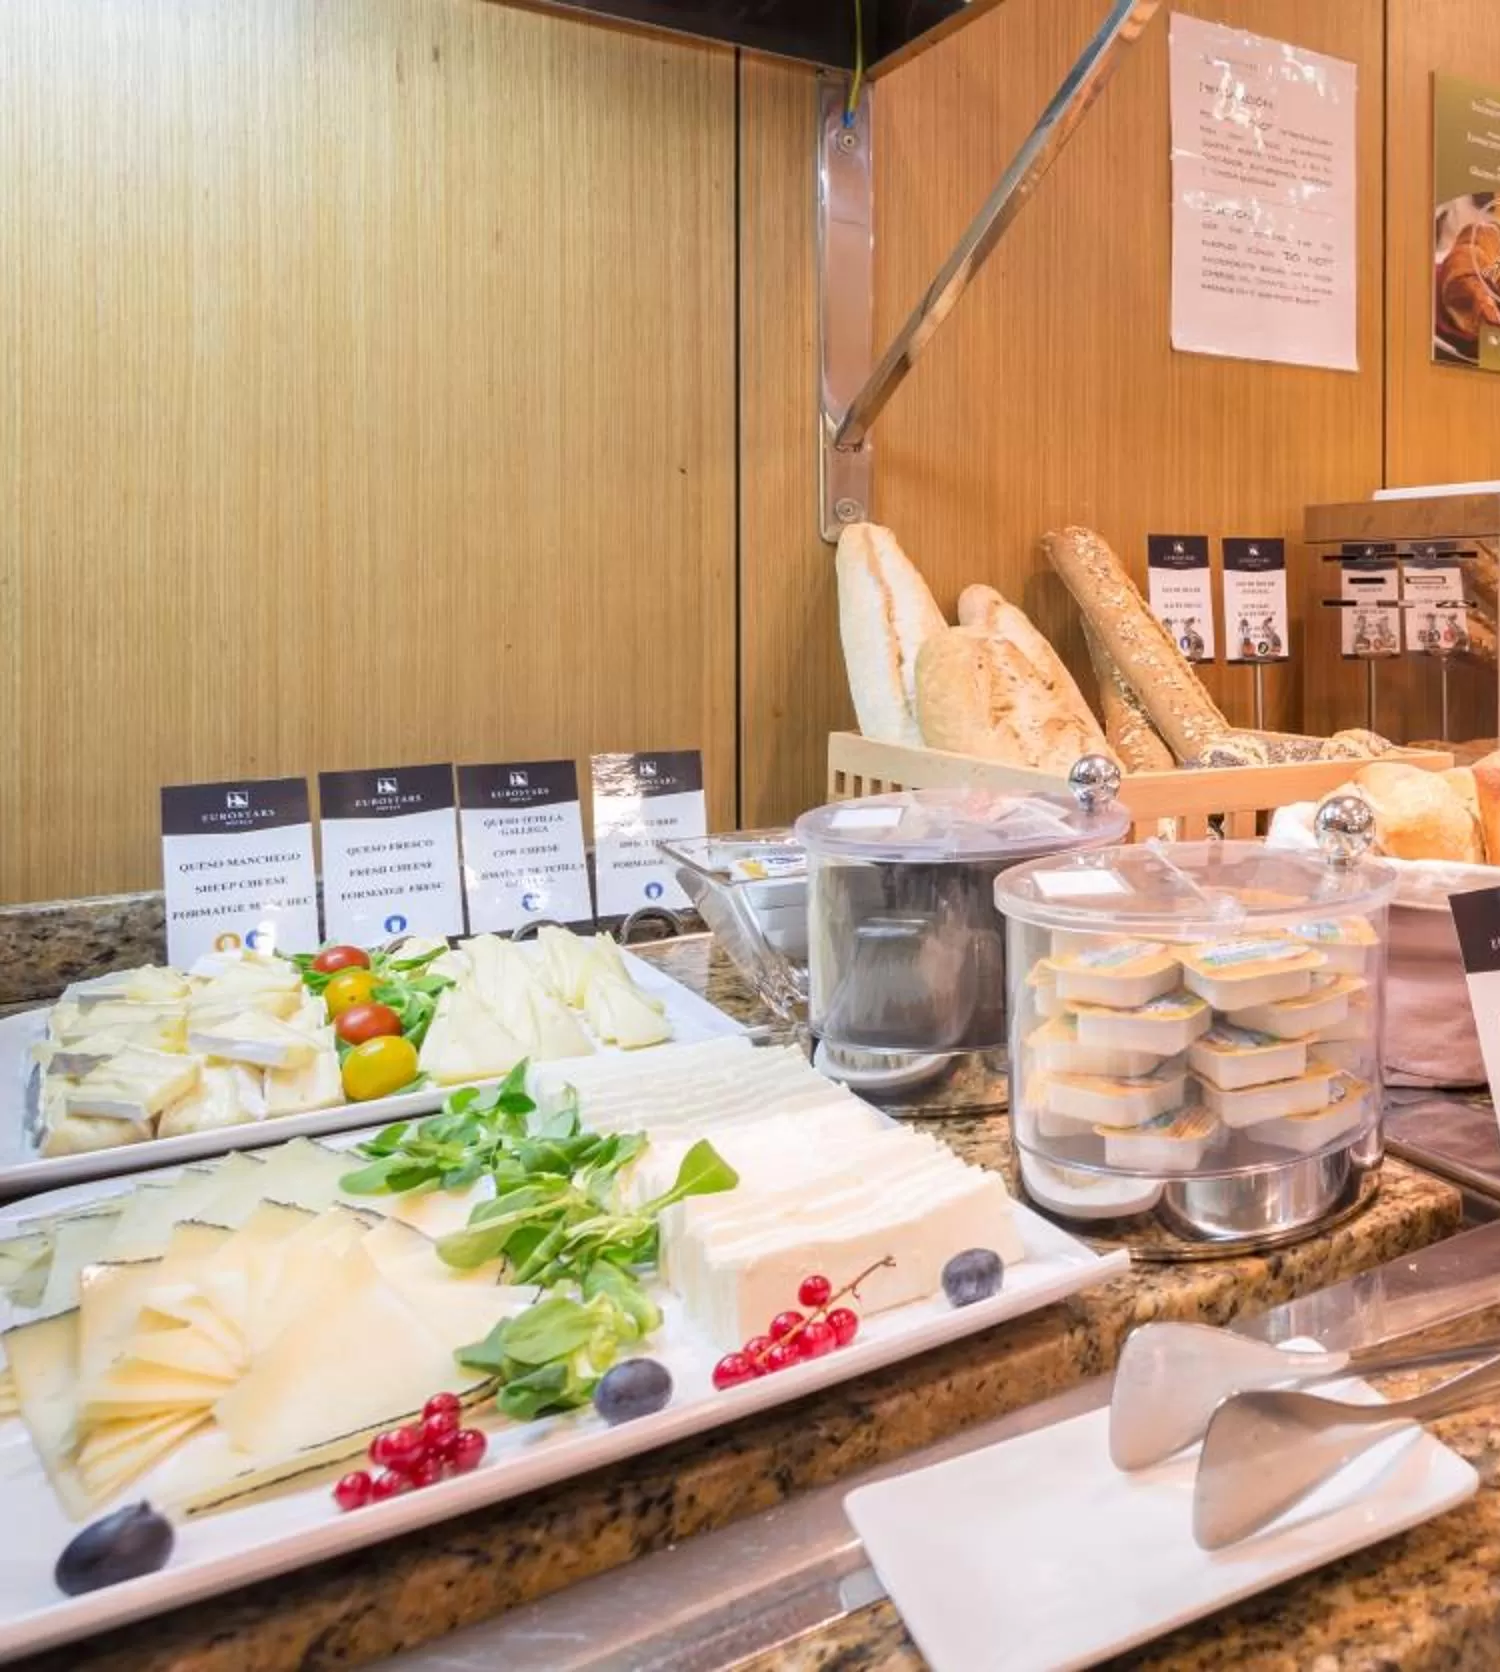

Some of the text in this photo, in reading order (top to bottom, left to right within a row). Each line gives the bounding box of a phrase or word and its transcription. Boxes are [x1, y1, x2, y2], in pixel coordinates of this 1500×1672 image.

[202, 809, 276, 823] EUROSTARS
[346, 839, 434, 857] QUESO FRESCO
[179, 851, 302, 873] QUESO MANCHEGO
[194, 876, 288, 895] SHEEP CHEESE
[341, 886, 404, 901] FORMATGE
[172, 902, 245, 921] FORMATGE
